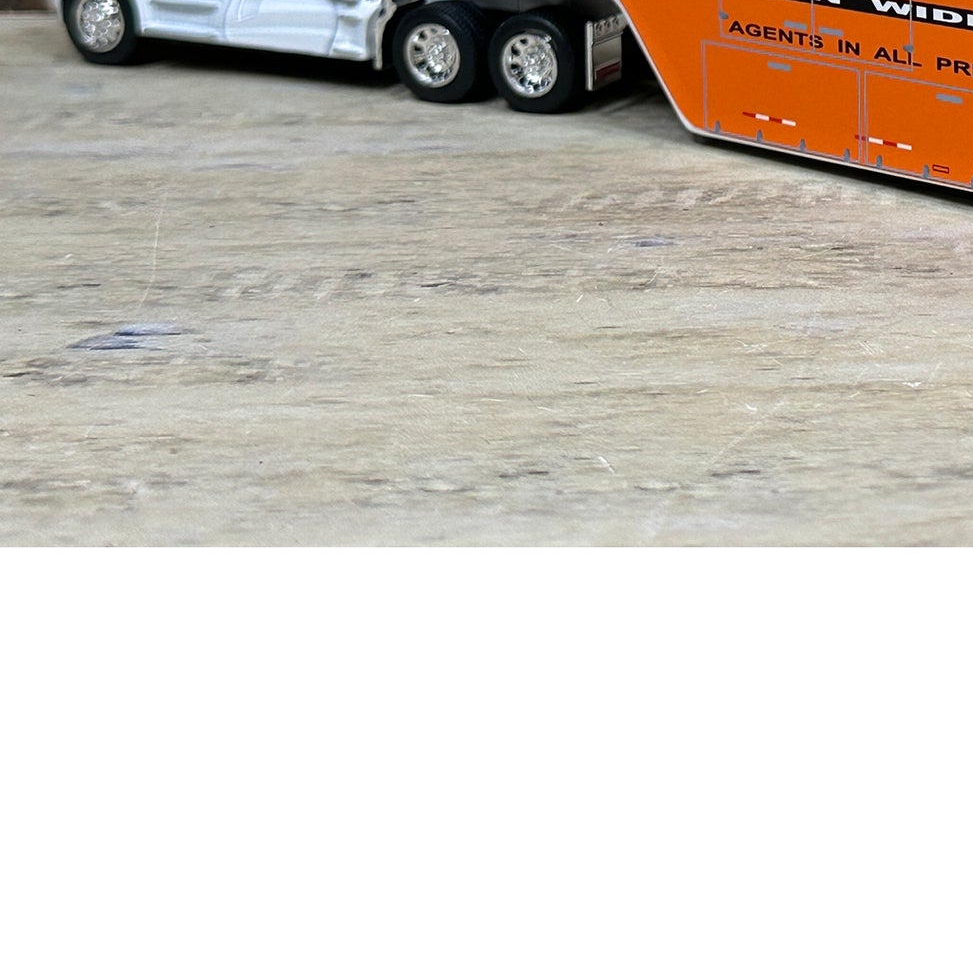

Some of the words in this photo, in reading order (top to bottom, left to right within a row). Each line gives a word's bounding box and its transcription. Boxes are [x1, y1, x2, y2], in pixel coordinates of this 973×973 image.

[728, 20, 824, 49] AGENTS
[838, 39, 861, 56] IN
[873, 46, 922, 67] ALL
